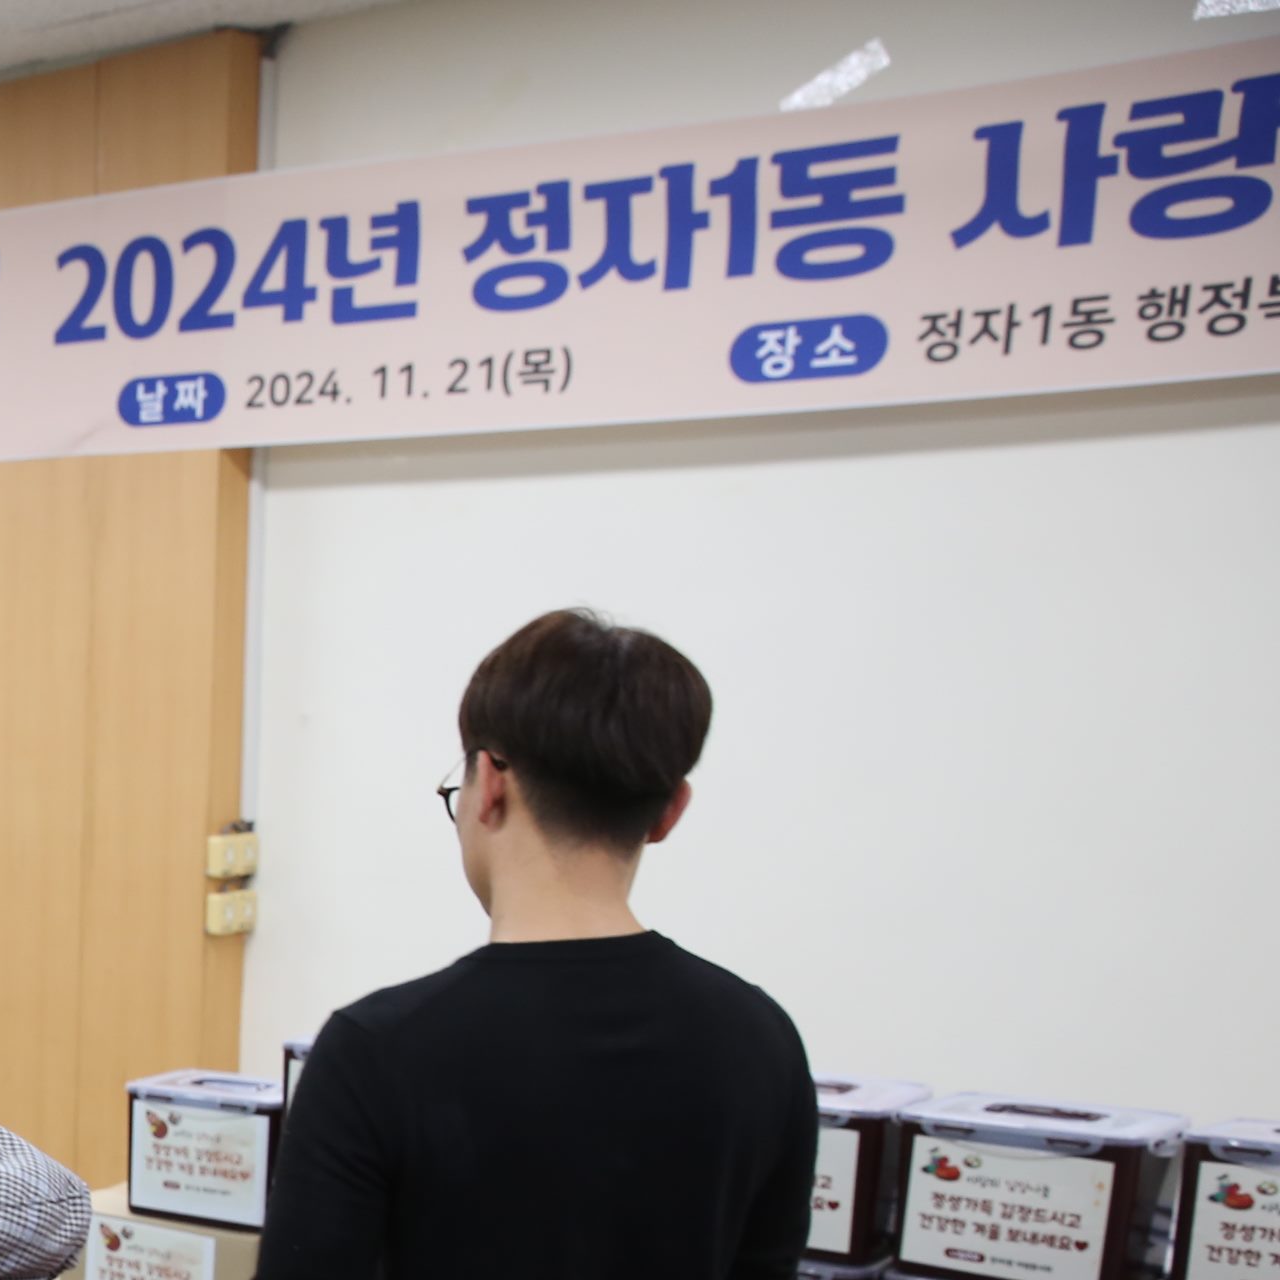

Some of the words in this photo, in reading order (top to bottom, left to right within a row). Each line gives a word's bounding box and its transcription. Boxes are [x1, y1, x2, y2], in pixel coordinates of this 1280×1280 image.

[52, 201, 421, 347] 2024년
[462, 134, 906, 312] 정자1동
[949, 73, 1280, 251] 사랑
[916, 294, 1116, 364] 정자1동
[447, 345, 574, 396] 21(목)
